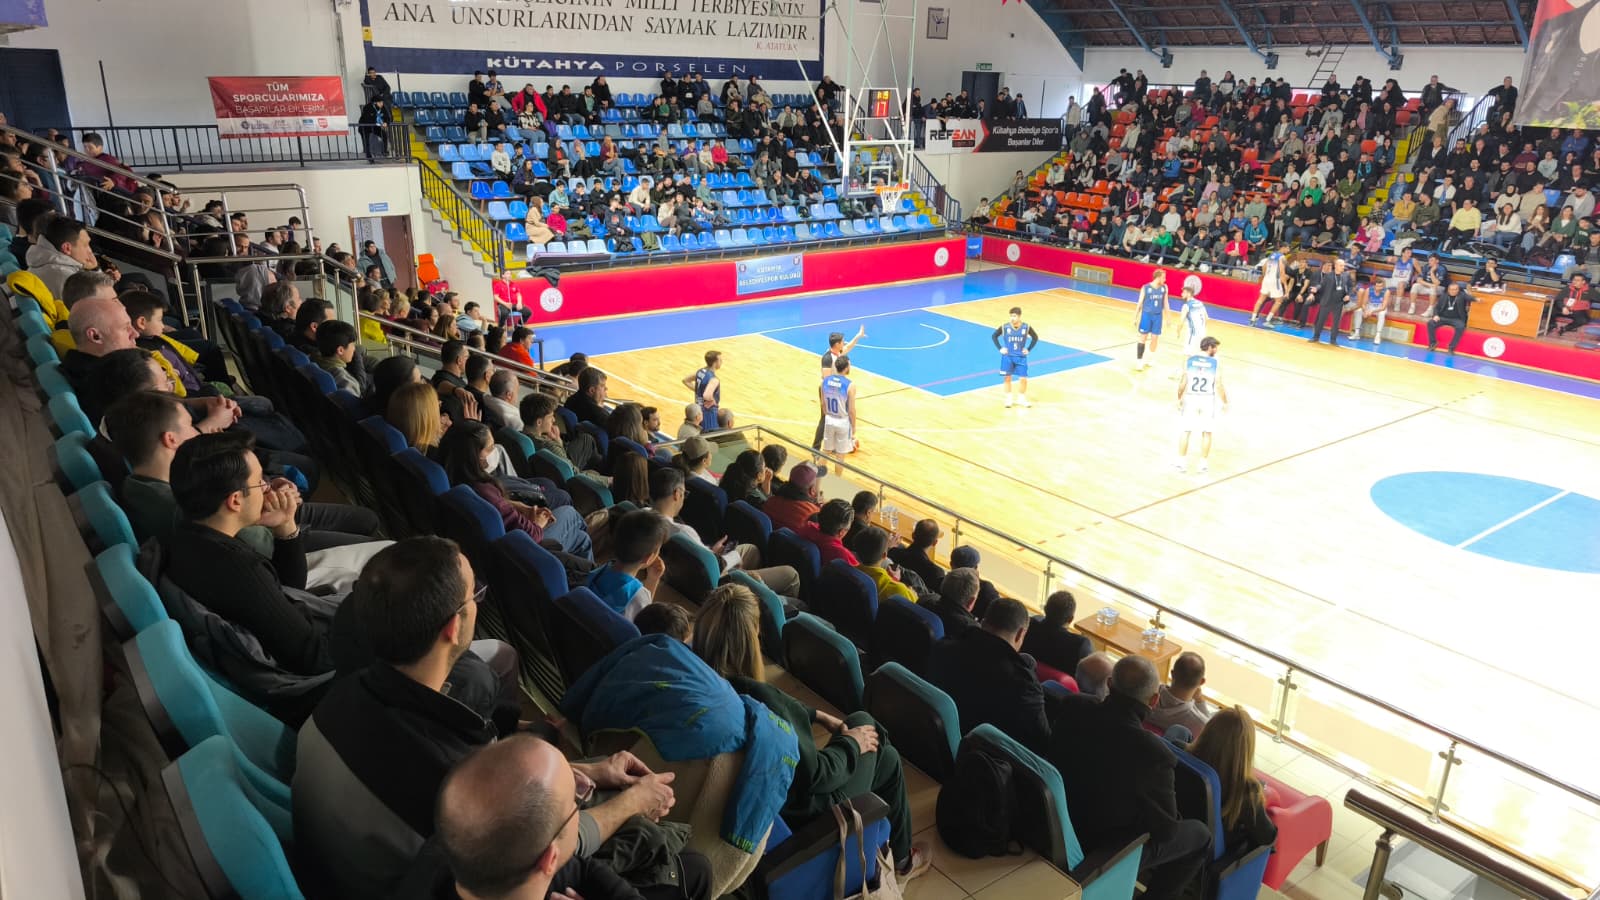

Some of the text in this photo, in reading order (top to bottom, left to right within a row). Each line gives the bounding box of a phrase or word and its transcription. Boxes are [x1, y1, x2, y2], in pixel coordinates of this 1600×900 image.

[384, 3, 437, 24] ANA
[451, 6, 633, 33] UNSURLARINDAN
[644, 16, 717, 36] SAYMAK
[486, 56, 746, 74] KÜTAHYA PORSELEN
[266, 81, 289, 92] TÜM
[233, 93, 325, 103] SPORCULARIMIZA
[929, 128, 976, 141] REFSAN
[1191, 376, 1208, 393] 22
[826, 397, 838, 414] 10
